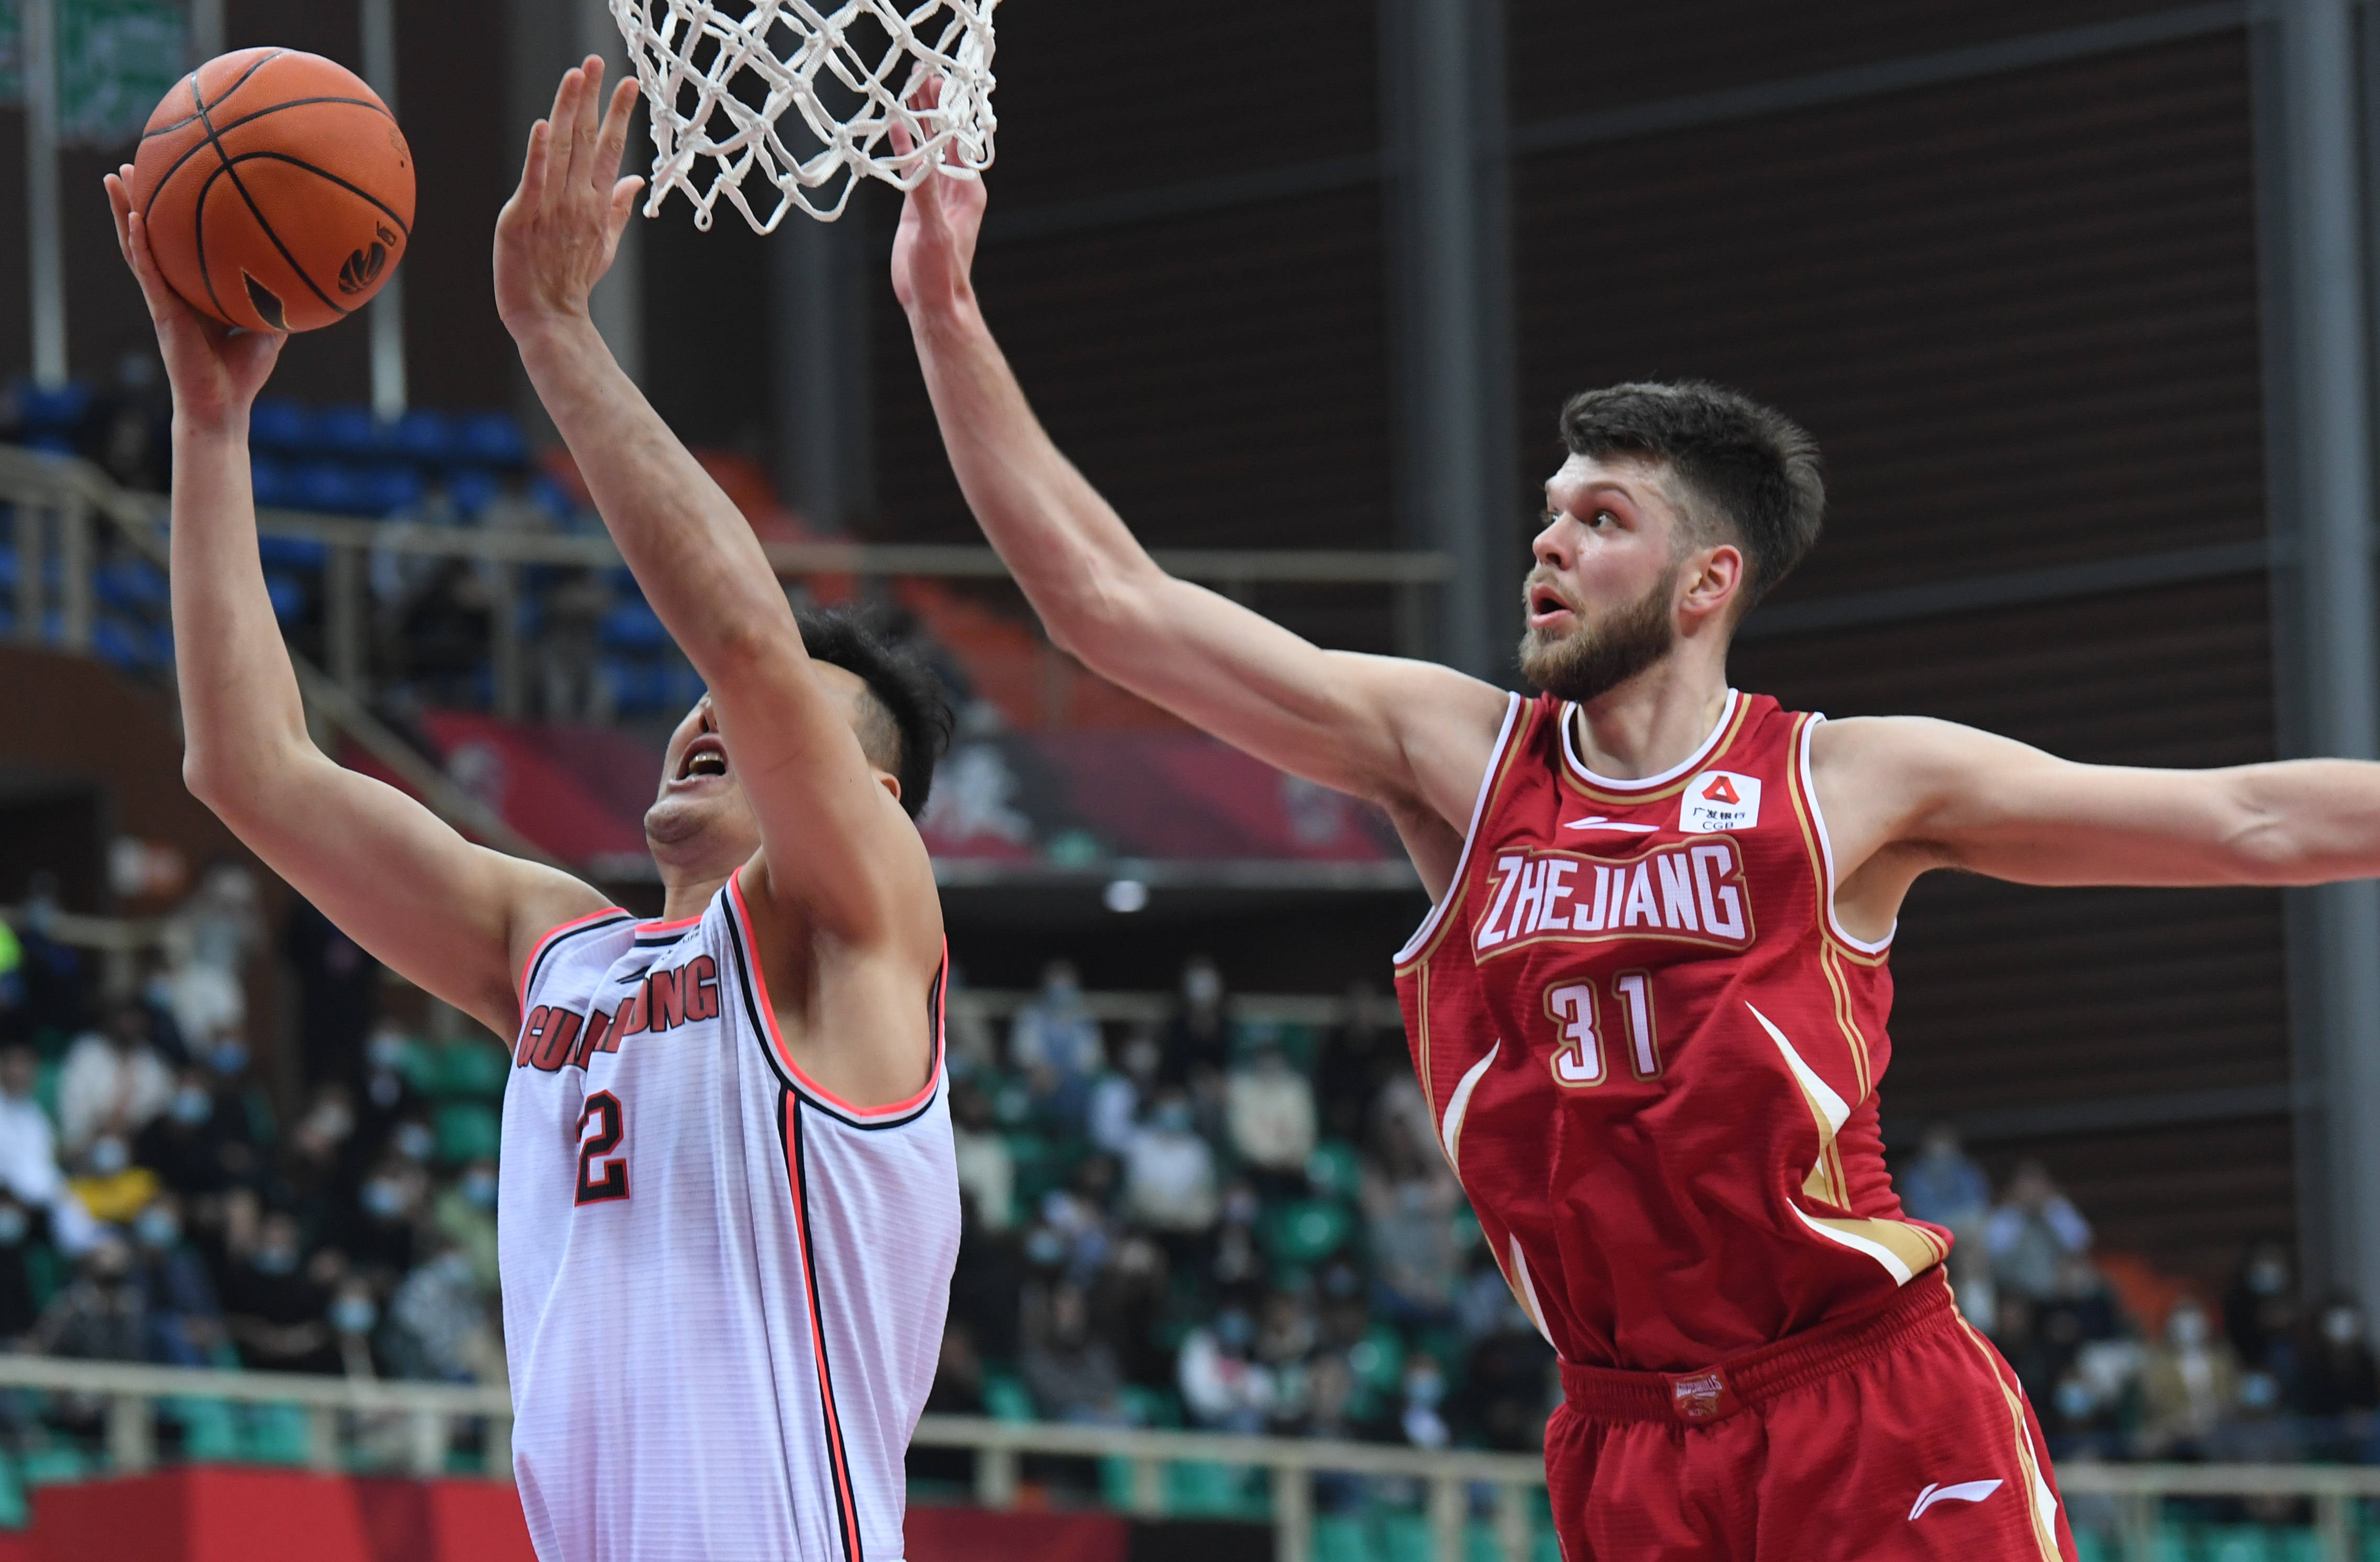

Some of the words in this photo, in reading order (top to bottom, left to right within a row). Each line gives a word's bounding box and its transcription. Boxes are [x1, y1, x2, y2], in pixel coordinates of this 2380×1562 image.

[1477, 844, 1746, 950] ZHEJIANG
[1547, 972, 1658, 1083] 31
[575, 1089, 630, 1207] 2
